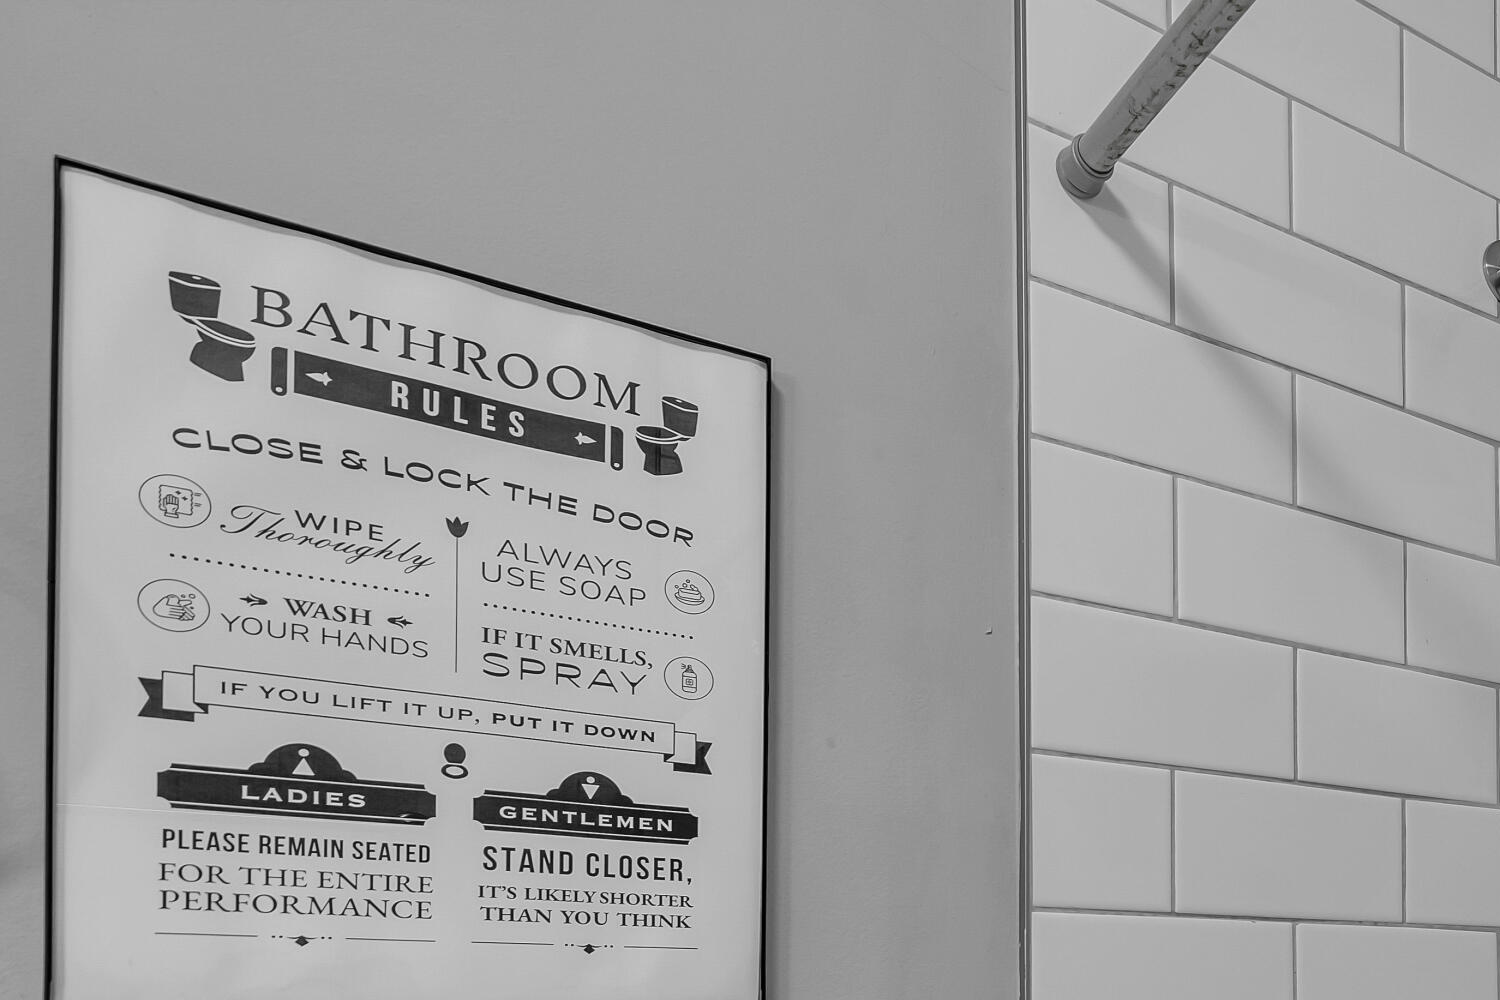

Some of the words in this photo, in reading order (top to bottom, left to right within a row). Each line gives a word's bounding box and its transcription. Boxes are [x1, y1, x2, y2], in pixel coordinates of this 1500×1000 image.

[250, 285, 640, 416] BATHROOM
[392, 381, 524, 437] RULES
[172, 428, 323, 464] CLOSE
[341, 449, 367, 472] &
[384, 456, 491, 496] LOCK
[503, 482, 577, 516] THE
[593, 504, 693, 547] DOOR
[219, 505, 436, 574] Thoroughly
[294, 510, 383, 542] WIPE
[497, 540, 631, 581] ALWAYS
[482, 562, 545, 591] USE
[559, 576, 646, 606] SOAP
[283, 598, 372, 626] WASH
[221, 613, 309, 642] YOUR
[322, 627, 428, 658] HANDS
[481, 627, 507, 645] IF
[515, 632, 542, 651] IT
[550, 638, 652, 669] SMELLS,
[483, 653, 647, 695] SPRAY
[221, 681, 246, 695] IF
[259, 686, 319, 704] YOU
[333, 695, 392, 712] LIFT
[404, 703, 427, 716] IT
[439, 706, 479, 725] UP,
[492, 713, 542, 729] PUT
[552, 720, 574, 733] IT
[584, 724, 654, 742] DOWN
[242, 785, 365, 807] LADIES
[500, 806, 672, 831] GENTLEMEN
[162, 828, 250, 853] PLEASE
[259, 835, 343, 858] REMAIN
[352, 841, 430, 863] SEATED
[483, 846, 573, 875] STAND
[586, 853, 691, 885] CLOSER,
[158, 863, 230, 884] FOR
[238, 867, 307, 887] THE
[317, 871, 433, 893] ENTIRE
[524, 888, 596, 903] LIKELY
[600, 892, 694, 908] SHORTER
[159, 890, 432, 919] PERFORMANCE
[480, 906, 552, 923] THAN
[560, 910, 609, 925] YOU
[616, 913, 691, 928] THINK
